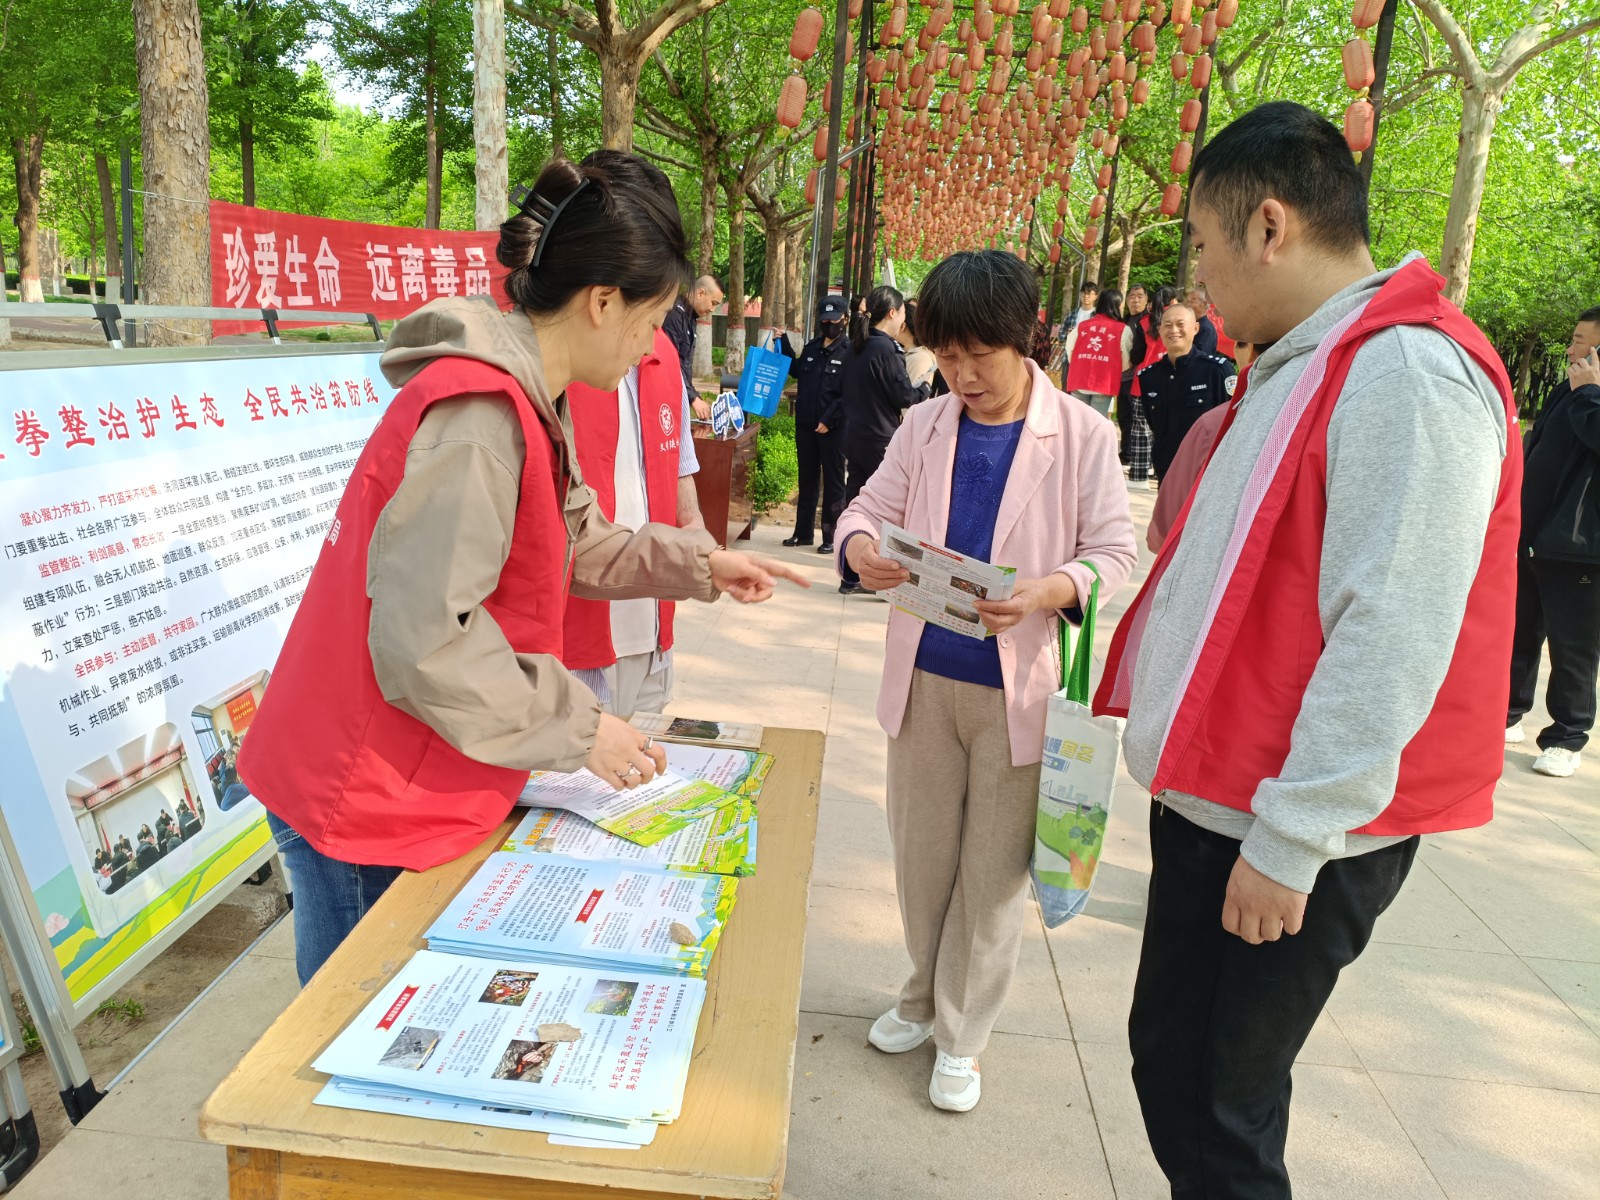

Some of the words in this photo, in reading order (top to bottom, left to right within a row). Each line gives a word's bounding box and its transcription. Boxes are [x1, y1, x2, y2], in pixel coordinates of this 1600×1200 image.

[222, 226, 342, 309] 珍爱生命
[366, 241, 491, 302] 远离毒品
[0, 391, 226, 460] 拳整治护生态
[243, 377, 380, 422] 全民共治筑防线
[40, 601, 167, 664] 力，立案查处严惩，绝不姑息。
[473, 863, 535, 931] 保护人民群众生命财产安全
